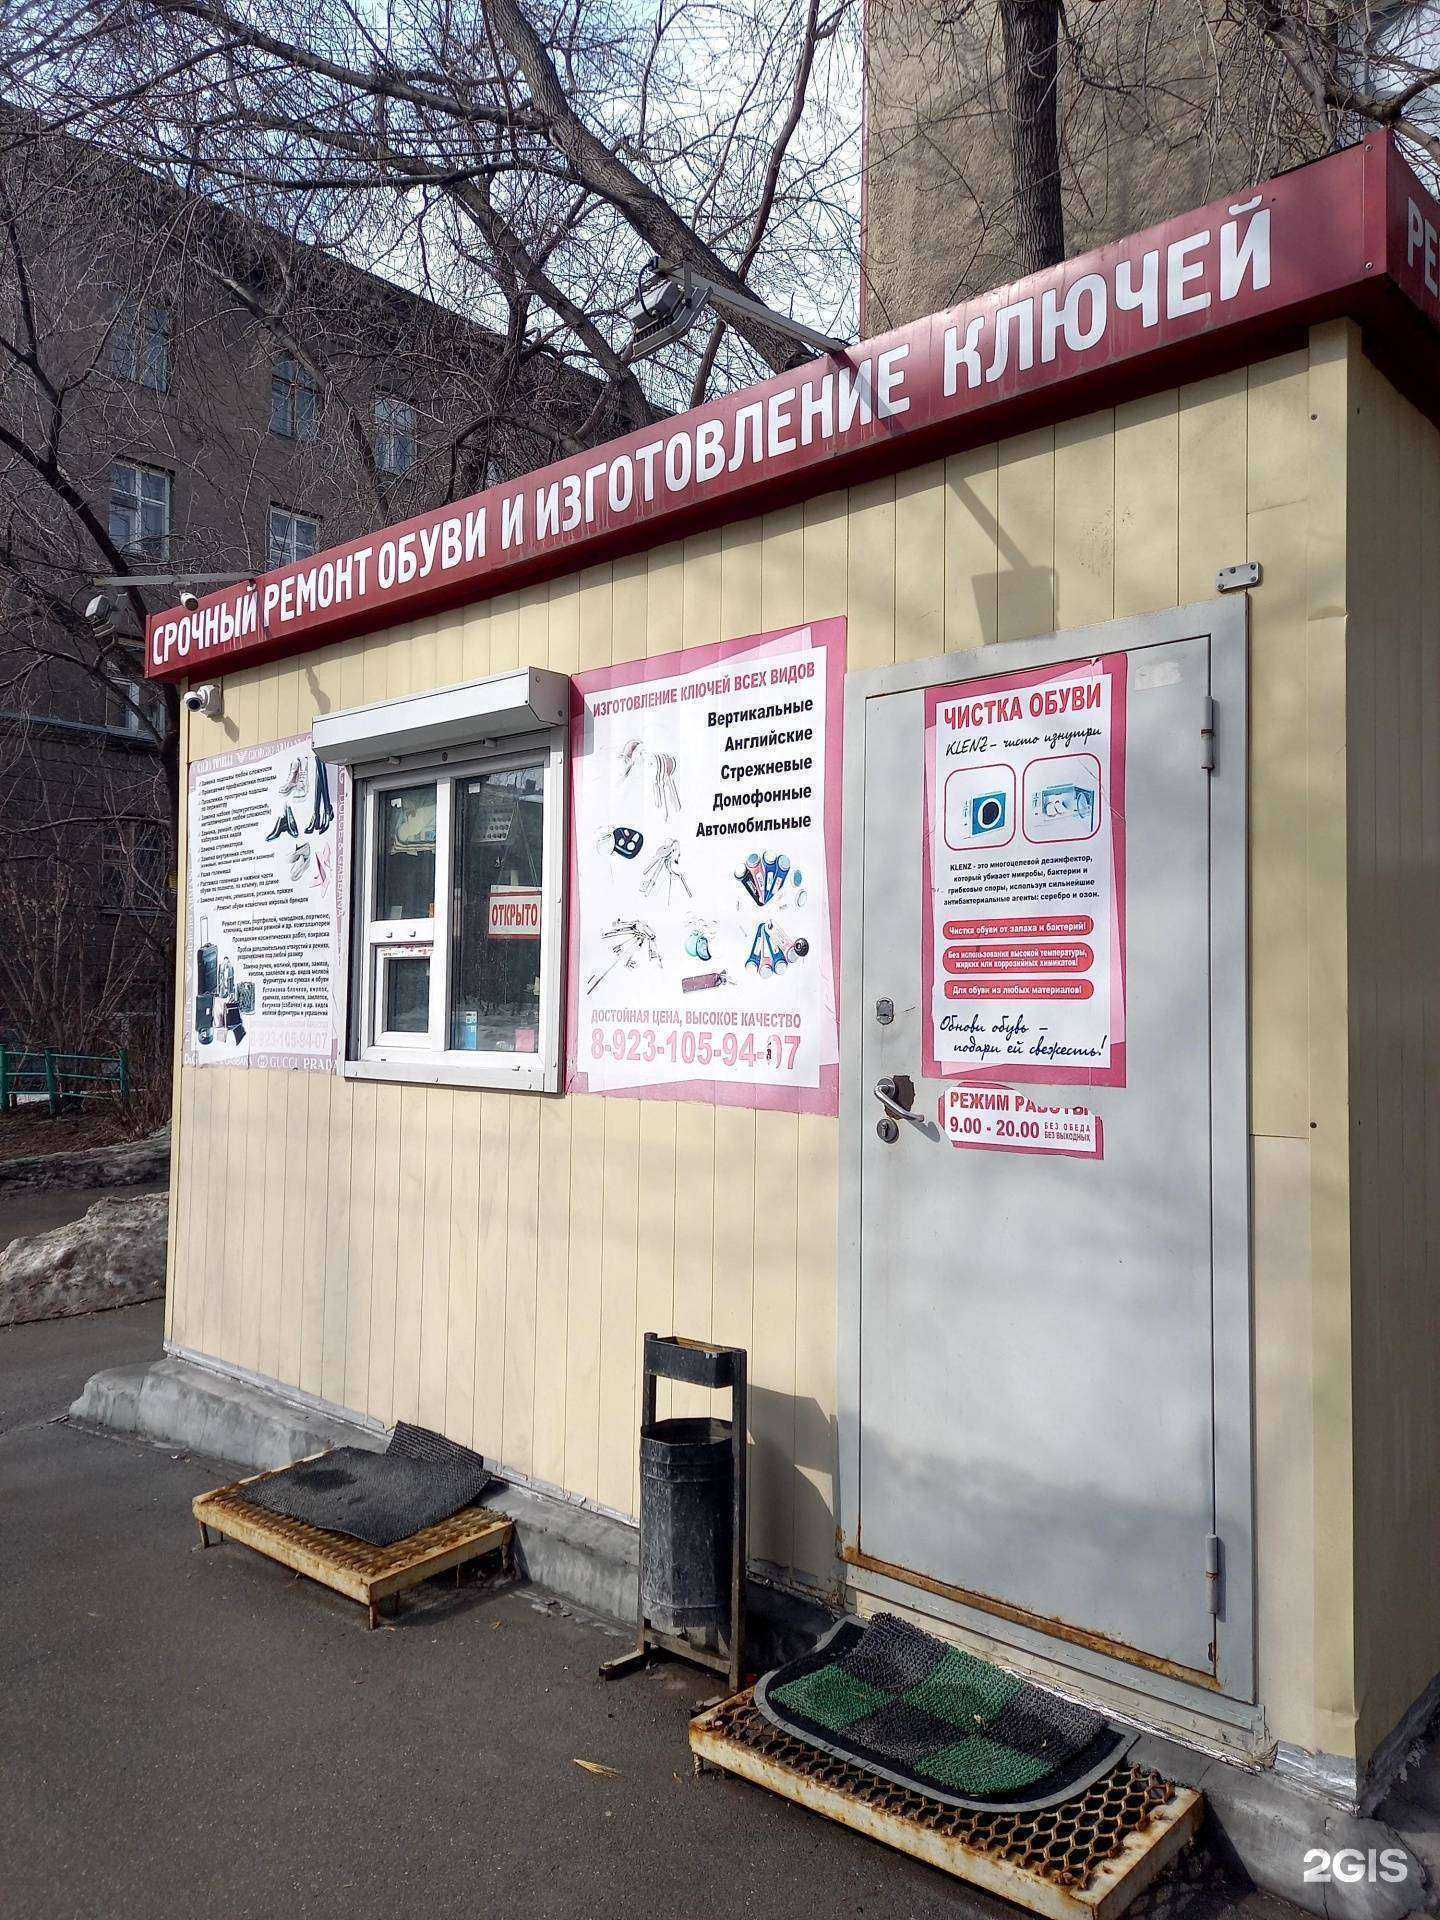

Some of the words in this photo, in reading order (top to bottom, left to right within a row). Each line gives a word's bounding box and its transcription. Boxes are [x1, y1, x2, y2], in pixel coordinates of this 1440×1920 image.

[152, 585, 257, 665] СРОЧНЫЙ
[263, 546, 373, 627] РЕМОНТ
[378, 507, 487, 591] ОБУВИ
[501, 493, 524, 550] И
[536, 343, 911, 541] ИЗГОТОВЛЕНИЕ
[943, 194, 1271, 398] КЛЮЧЕЙ
[593, 688, 678, 718] ИЗГОТОВЛЕНИЕ
[680, 674, 731, 702] КЛЮЧЕЙ
[734, 670, 767, 692] ВСЕХ
[770, 661, 815, 685] ВИДОВ
[707, 697, 814, 728] Вертикальные
[944, 697, 1022, 730] ЧИСТКА
[1029, 683, 1101, 717] ОБУВИ
[724, 726, 813, 753] Английские
[1044, 727, 1102, 749] изнутри
[720, 754, 813, 782] Стрежневые
[712, 784, 812, 812] Домофонные
[696, 813, 812, 838] Автомобильные
[990, 858, 1040, 869] многоцелевой
[1041, 855, 1093, 865] дезинфектор,
[954, 874, 982, 883] который
[983, 873, 1010, 882] убивает
[1011, 870, 1046, 879] микробы,
[1047, 868, 1081, 876] бактерии
[948, 886, 983, 895] грибковые
[984, 884, 1008, 893] споры,
[1009, 882, 1047, 891] используя
[1048, 879, 1095, 888] сильнейшие
[943, 896, 1011, 906] антибактериальные
[1011, 894, 1039, 902] агенты:
[1040, 892, 1071, 901] серебро
[491, 902, 538, 928] ОТКРЫТО
[949, 926, 975, 935] Чистка
[976, 925, 998, 936] обуви
[1009, 925, 1037, 934] запаха
[1046, 921, 1087, 932] бактерий!
[960, 951, 1009, 959] использования
[1010, 949, 1039, 958] высокой
[1040, 949, 1087, 958] температуры,
[953, 985, 967, 995] Для
[968, 985, 990, 995] обуви
[992, 986, 1001, 994] из
[1003, 985, 1030, 994] любых
[1031, 985, 1082, 995] материалов!
[591, 1008, 650, 1025] ДОСТОЙНАЯ
[652, 1010, 683, 1028] ЦЕНА,
[685, 1010, 738, 1026] ВЫСОКОЕ
[741, 1012, 802, 1029] КАЧЕСТВО
[939, 1013, 986, 1033] Обнови
[991, 1013, 1030, 1040] обувь
[953, 1036, 1001, 1060] подари
[1007, 1040, 1024, 1054] ей
[1029, 1034, 1108, 1060] свежесть!
[950, 1091, 1010, 1111] РЕЖИМ
[950, 1116, 982, 1135] 9.00
[996, 1119, 1040, 1138] 20.00
[1044, 1122, 1059, 1130] БЕЗ
[1063, 1123, 1091, 1132] ОБЕДА
[1056, 1132, 1091, 1142] ВЫХОДНЫХ
